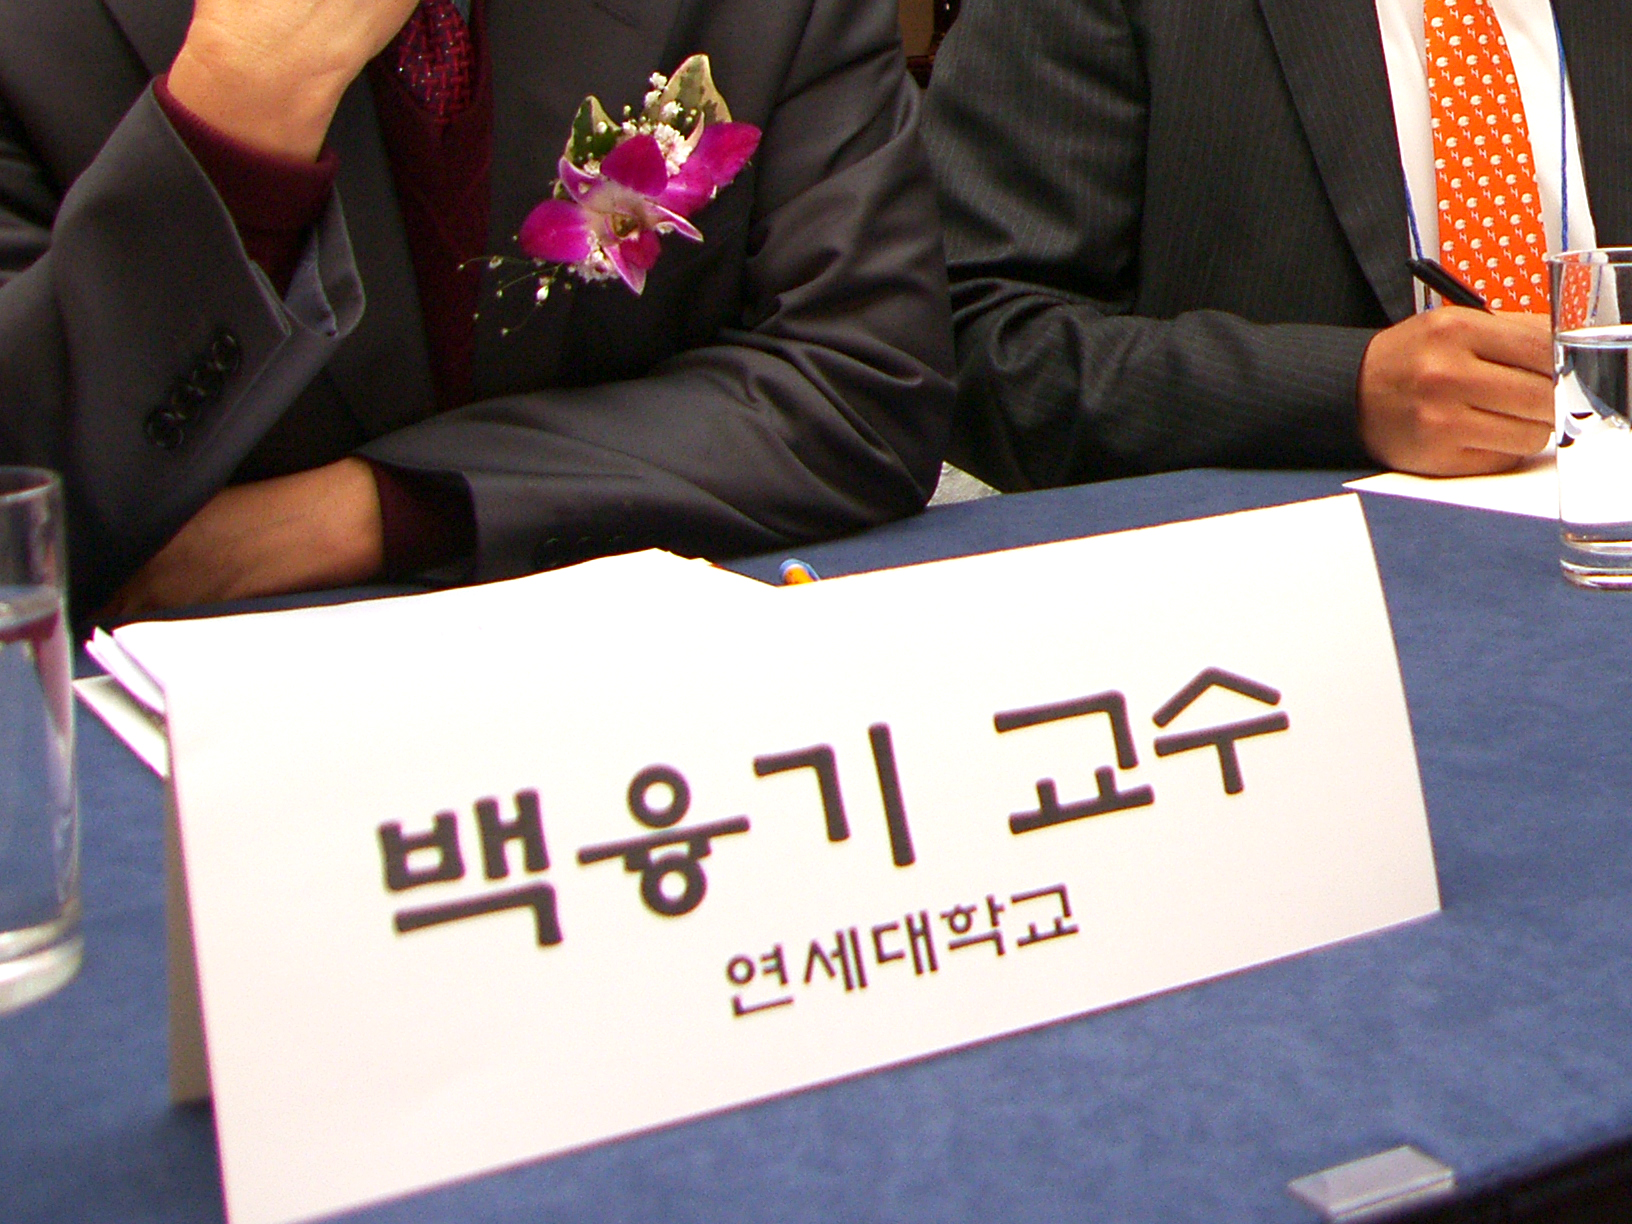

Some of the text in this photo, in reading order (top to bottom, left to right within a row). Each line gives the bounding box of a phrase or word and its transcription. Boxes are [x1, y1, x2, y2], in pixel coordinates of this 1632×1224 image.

[378, 668, 1290, 947] 백융기 교수
[726, 885, 1079, 1017] 연세대학교
